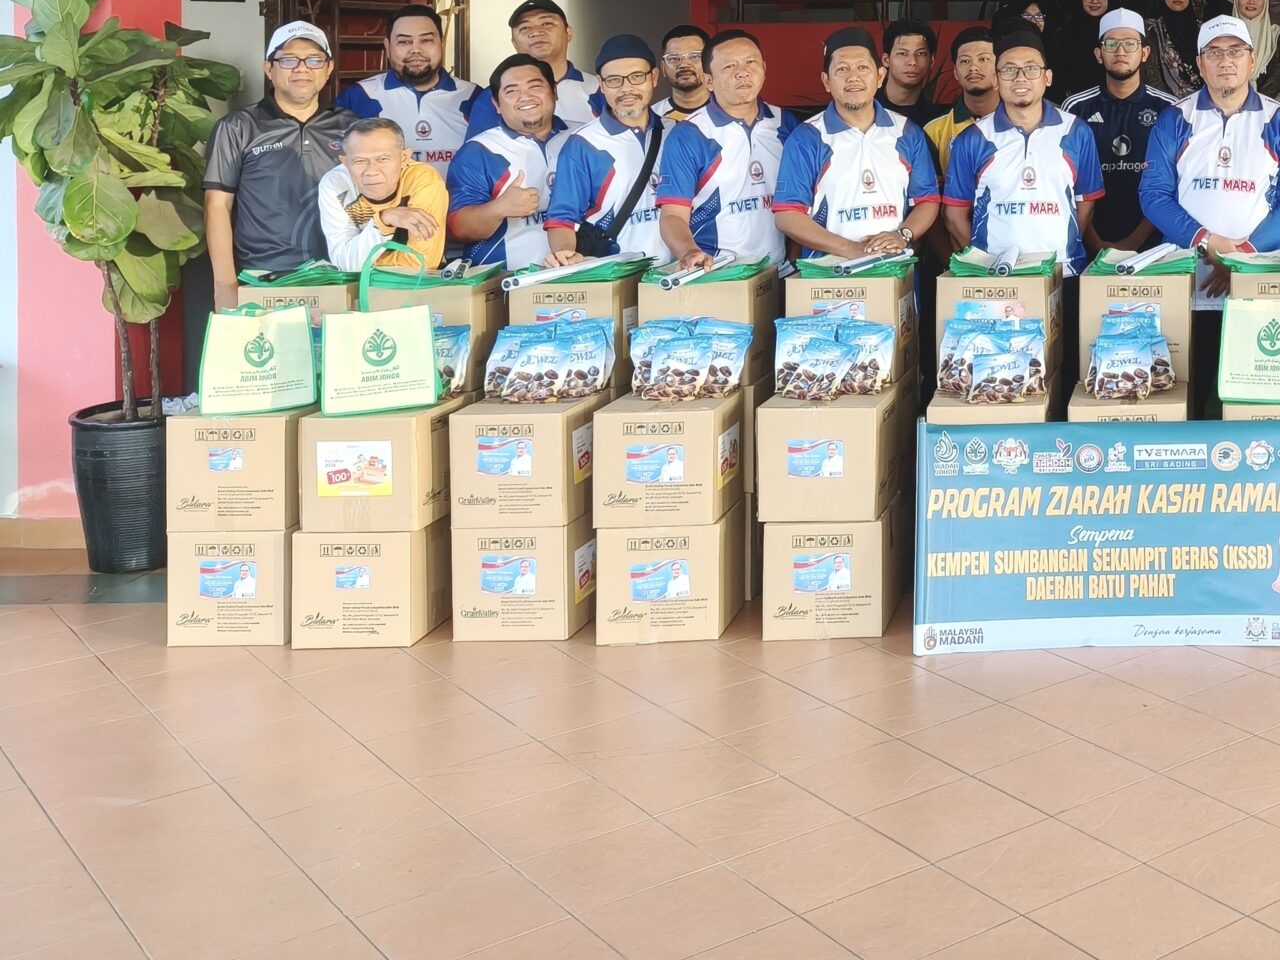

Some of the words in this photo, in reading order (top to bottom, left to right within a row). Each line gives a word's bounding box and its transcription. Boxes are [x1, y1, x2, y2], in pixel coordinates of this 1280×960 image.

[426, 151, 454, 162] MAR
[1193, 178, 1218, 191] TVET
[1223, 179, 1256, 192] MARA
[729, 198, 759, 215] TVET
[996, 202, 1025, 215] TVET
[1029, 200, 1060, 216] MARA
[524, 211, 547, 225] TVE
[838, 207, 868, 223] TVET
[520, 355, 558, 367] JEWEL
[570, 350, 596, 362] EWEL
[1106, 356, 1142, 369] JEWEL
[258, 373, 277, 381] JOHOR
[379, 374, 400, 382] JOHOR
[1145, 461, 1159, 469] SRI
[176, 496, 212, 511] Bidara
[458, 496, 497, 505] GrainValley
[603, 491, 640, 507] Bidara
[927, 486, 1041, 520] PROGRAM
[1046, 483, 1131, 516] ZIARAH
[1136, 483, 1206, 515] KASIH
[1067, 525, 1134, 546] Sempena
[927, 551, 989, 577] KEMPEN
[994, 549, 1088, 575] SUMBANGAN
[1093, 547, 1167, 572] SEKAMPIT
[1171, 546, 1219, 570] BERAS
[1223, 544, 1273, 570] (KSSB)
[1026, 575, 1083, 601] DAERAH
[1087, 574, 1125, 599] BATU
[1129, 573, 1176, 598] PAHAT
[461, 609, 499, 619] GrainValley
[607, 606, 645, 623] Bidara
[773, 602, 810, 618] Bidara
[176, 611, 212, 627] Bidara
[300, 612, 338, 628] Bidara
[939, 628, 984, 636] MALAYSIA
[1133, 623, 1170, 638] Dengan
[1173, 625, 1222, 638] kerjasama
[939, 636, 984, 646] MADANI
